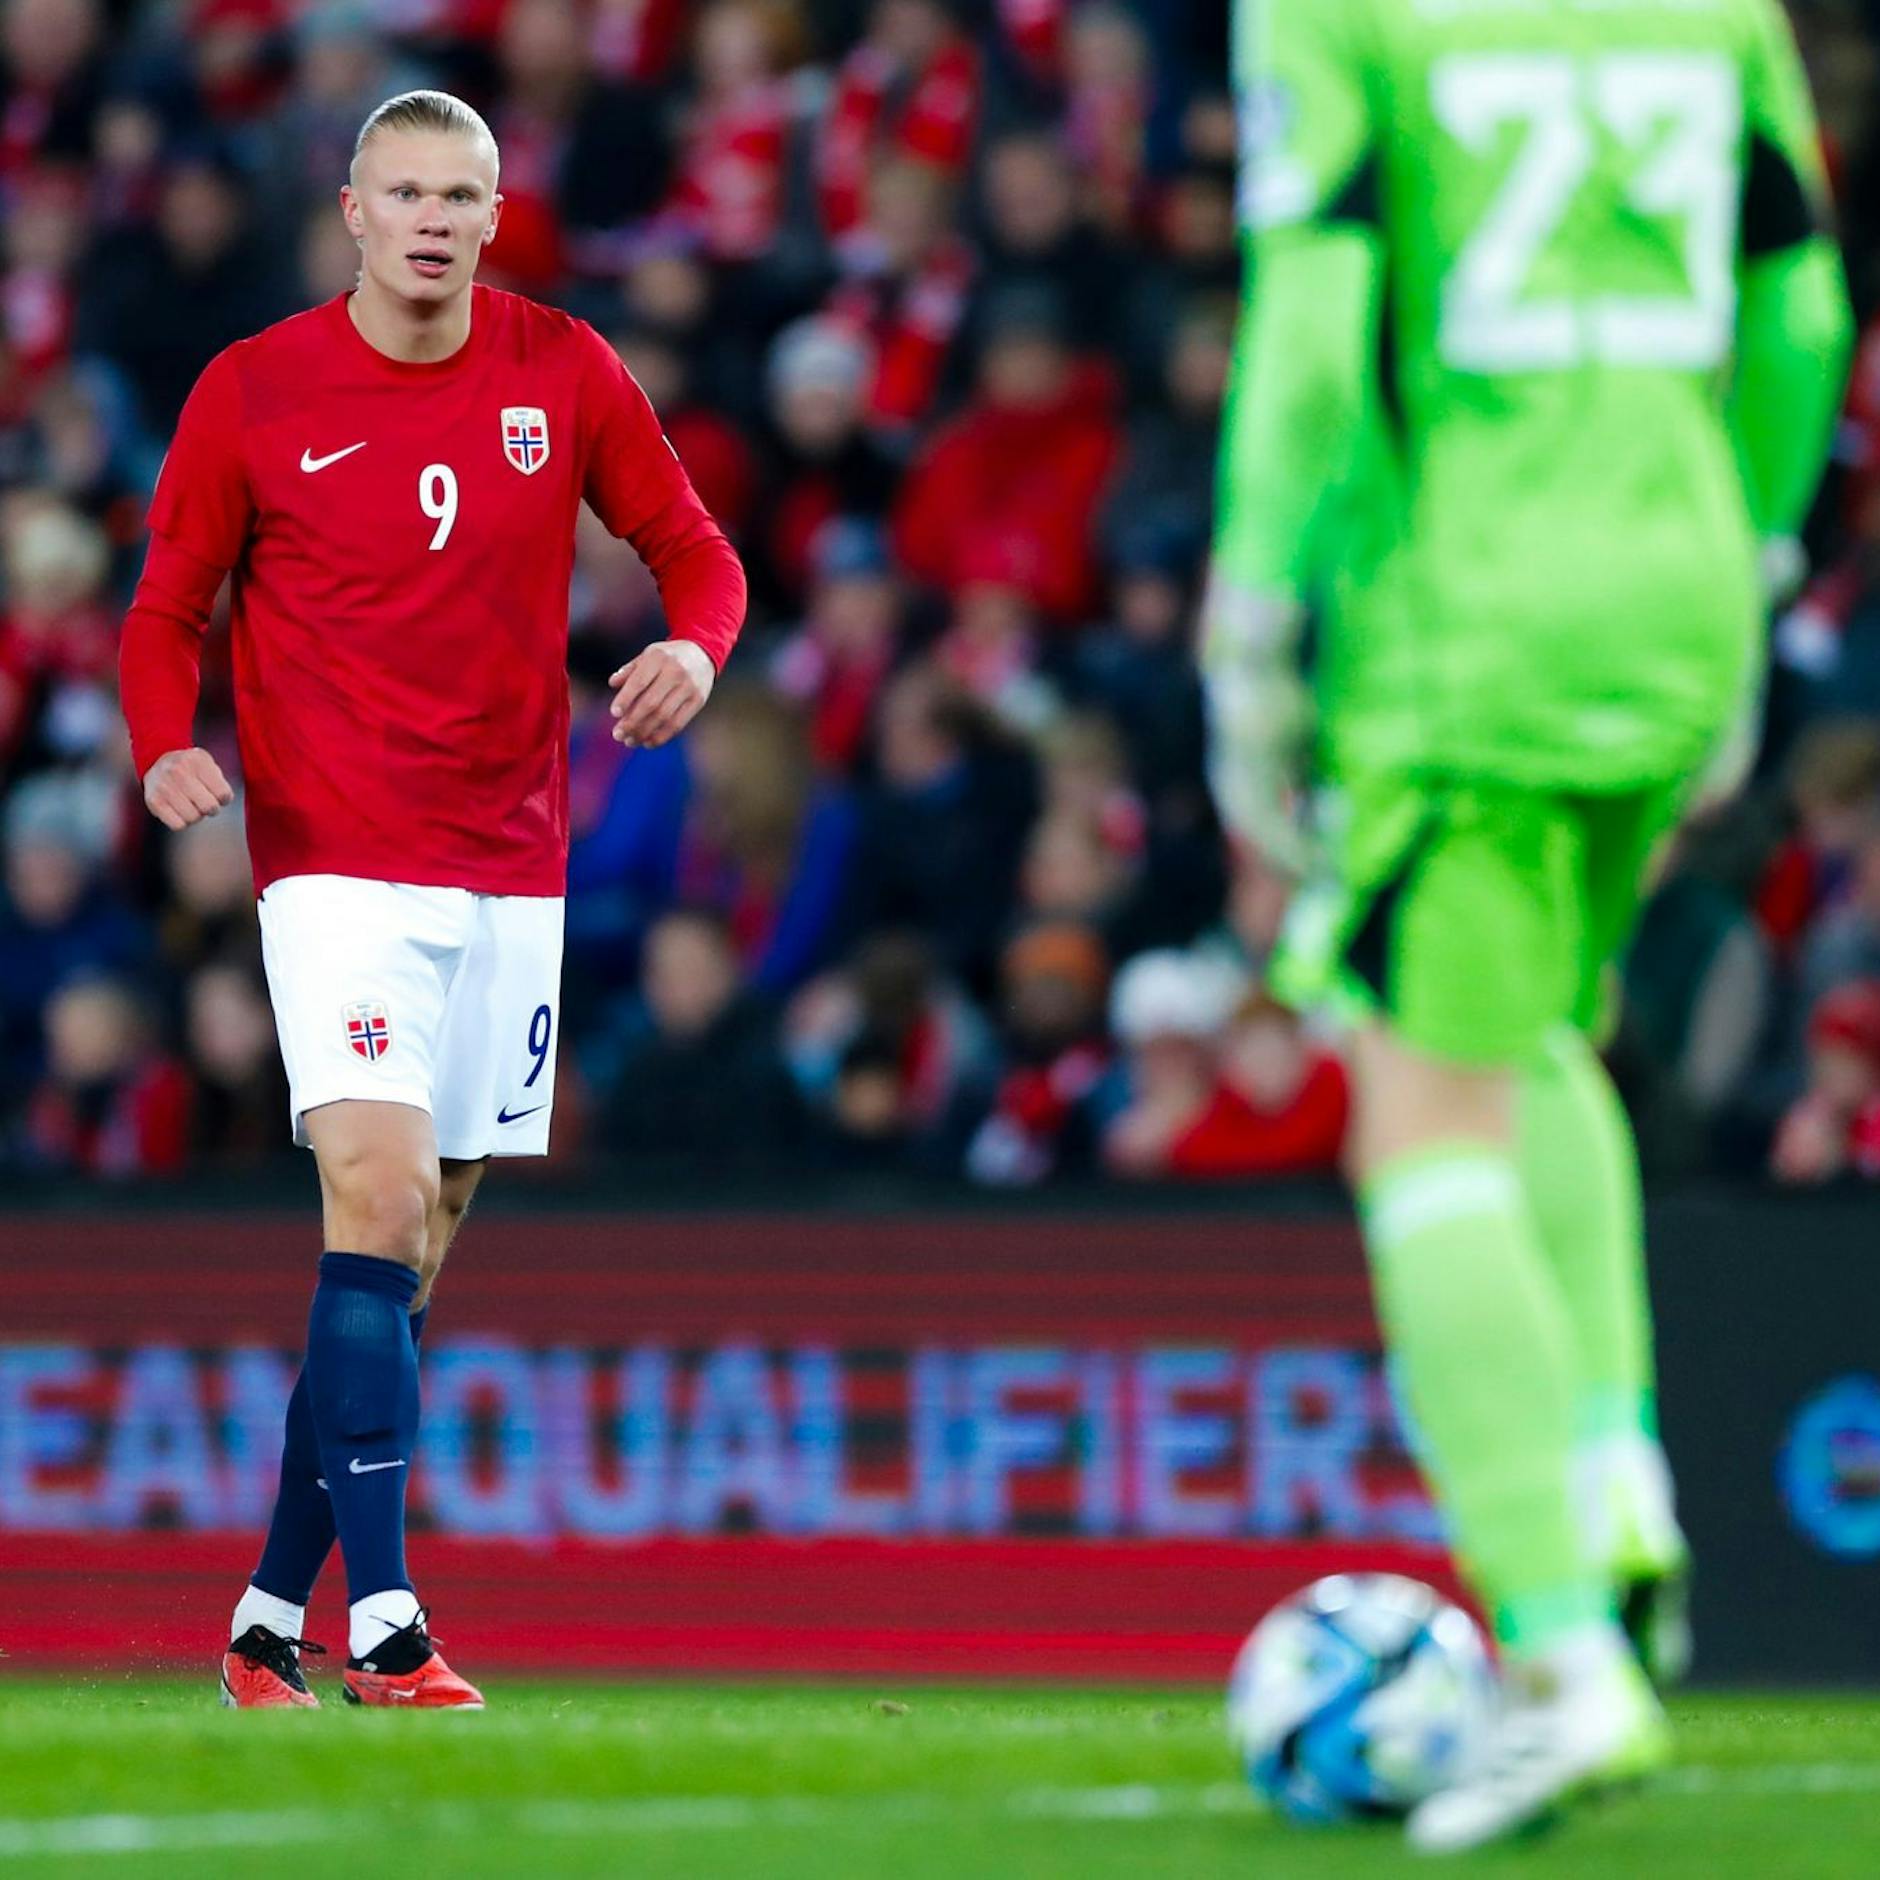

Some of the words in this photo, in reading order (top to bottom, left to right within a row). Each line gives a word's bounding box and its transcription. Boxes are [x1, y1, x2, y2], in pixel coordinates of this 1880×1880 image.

[1430, 52, 1738, 371] 23
[419, 463, 458, 550] 9
[524, 1004, 551, 1087] 9
